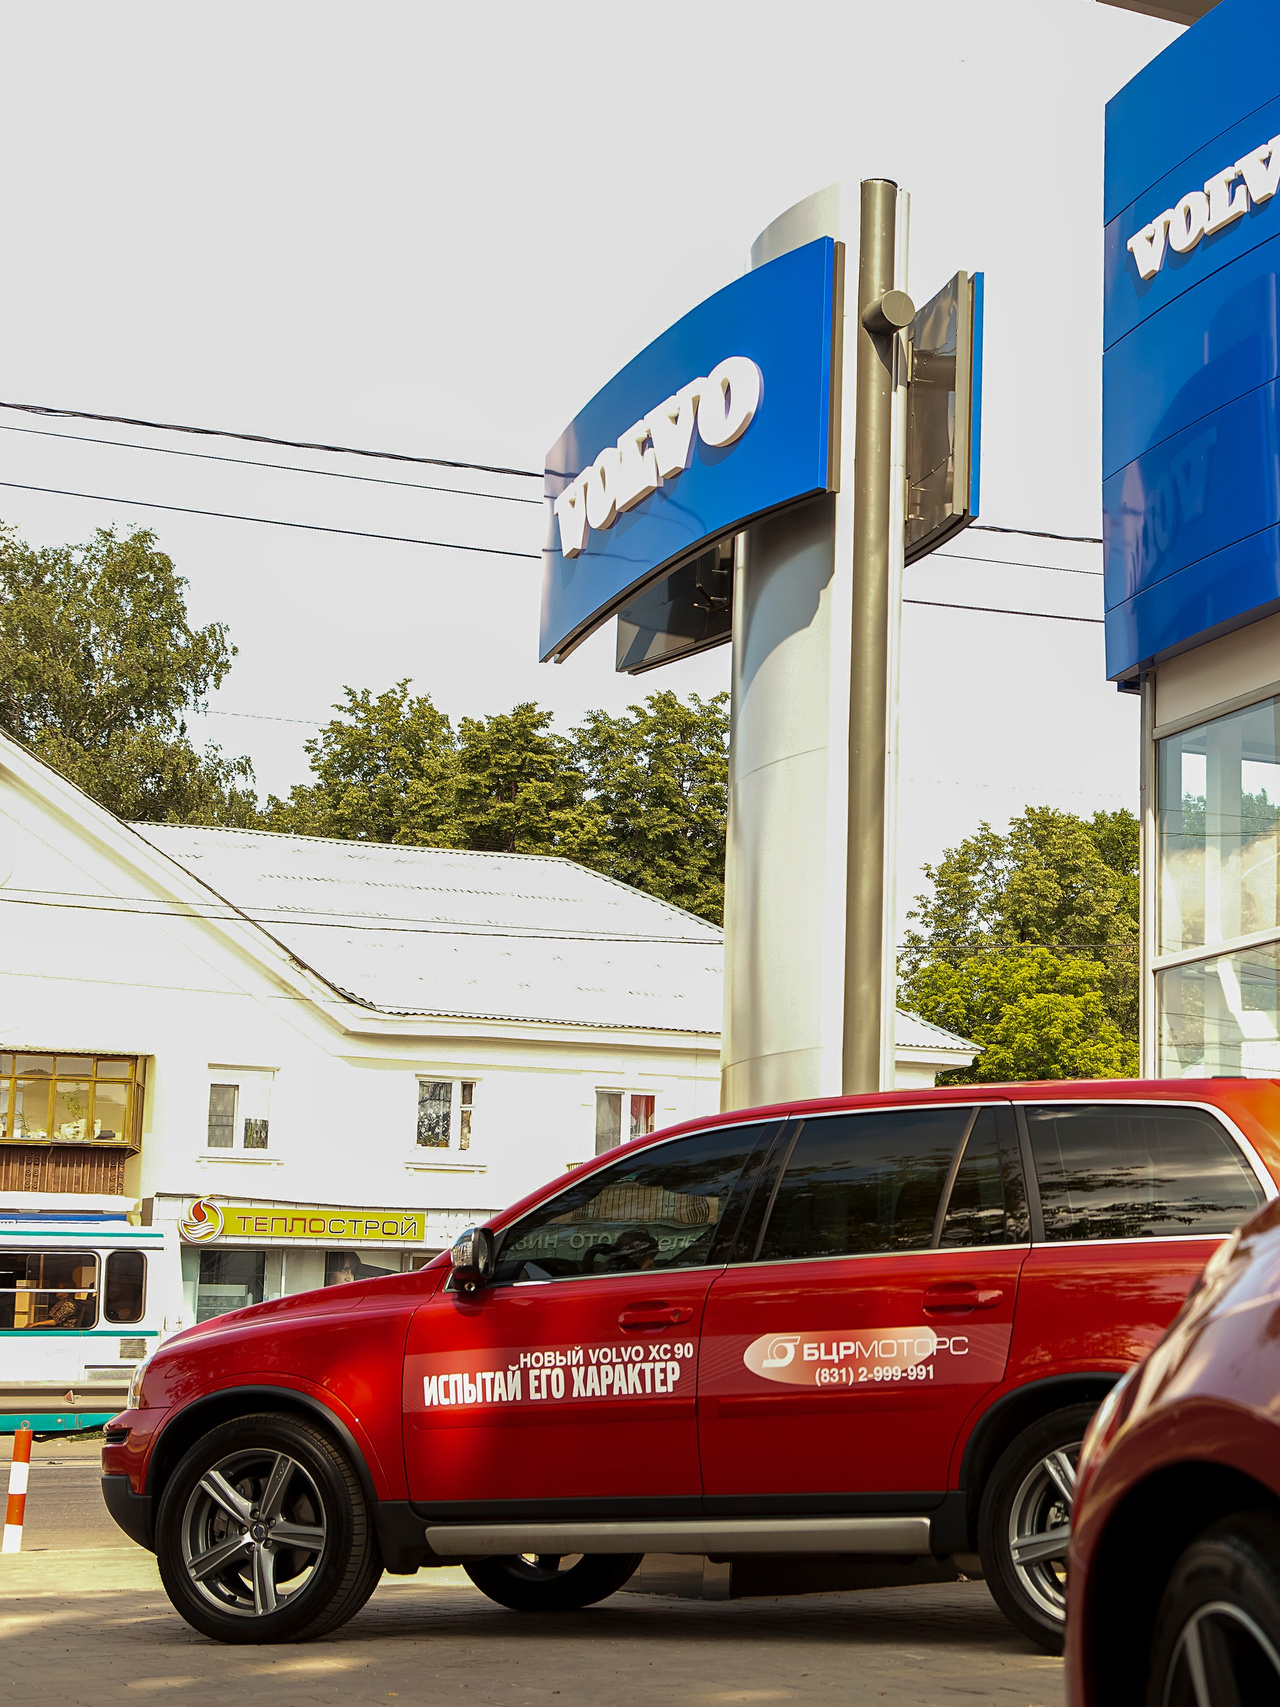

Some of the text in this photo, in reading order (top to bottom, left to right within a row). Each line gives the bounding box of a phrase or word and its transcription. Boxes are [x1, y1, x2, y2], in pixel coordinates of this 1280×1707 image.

[554, 356, 765, 560] VOLVO
[236, 1214, 418, 1238] ТЕПЛОСТРОЙ
[520, 1346, 584, 1368] НОВЫЙ
[588, 1347, 644, 1363] VOLVO
[803, 1336, 969, 1363] БЦРМОТОРС
[424, 1361, 681, 1406] ИСПЫТАЙ ЕГО ХАРАКТЕР
[814, 1364, 935, 1387] (831) 2-999-991
